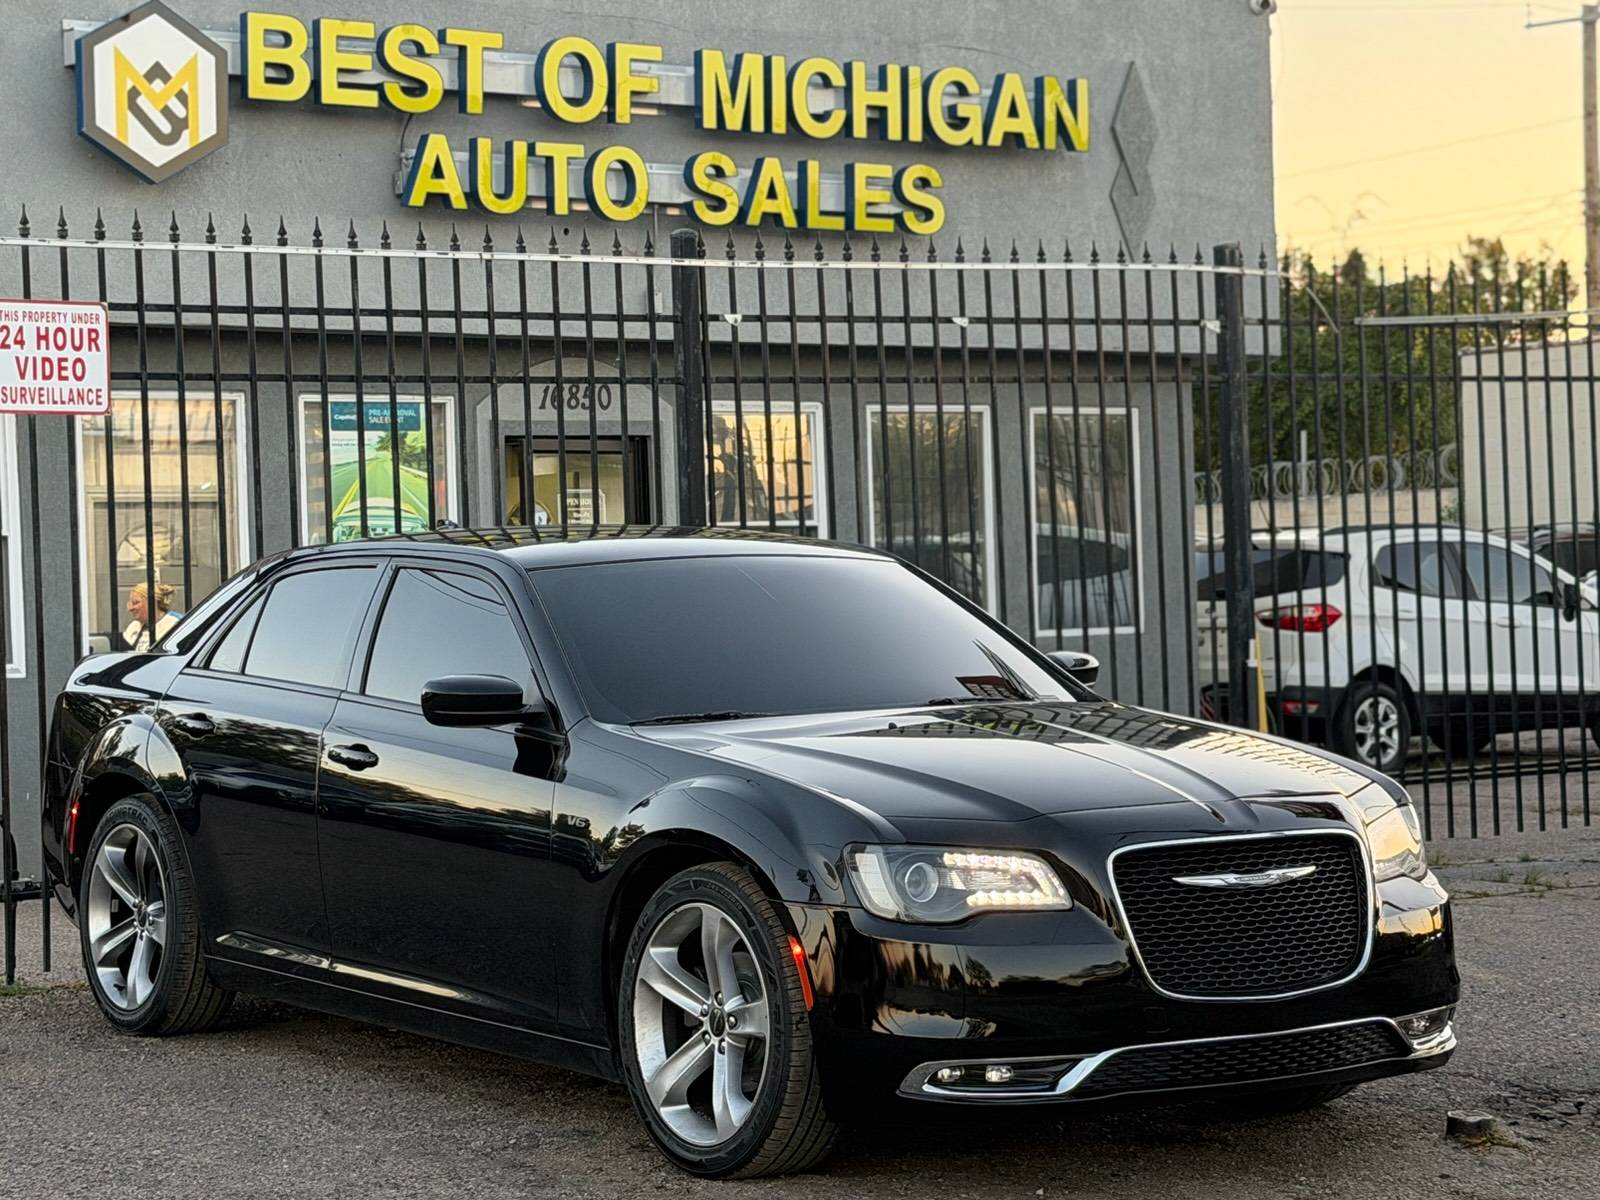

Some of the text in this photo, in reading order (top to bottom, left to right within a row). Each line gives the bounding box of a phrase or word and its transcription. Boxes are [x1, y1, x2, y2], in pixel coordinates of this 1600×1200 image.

[241, 11, 1090, 152] BEST OF MICHIGAN
[403, 133, 946, 235] AUTO SALES
[22, 311, 68, 325] PROPERTY
[71, 313, 101, 326] UNDER
[0, 325, 101, 352] 24 HOUR
[15, 356, 87, 382] VIDEO
[1, 386, 103, 406] SURVEILLANCE
[567, 815, 586, 828] V6
